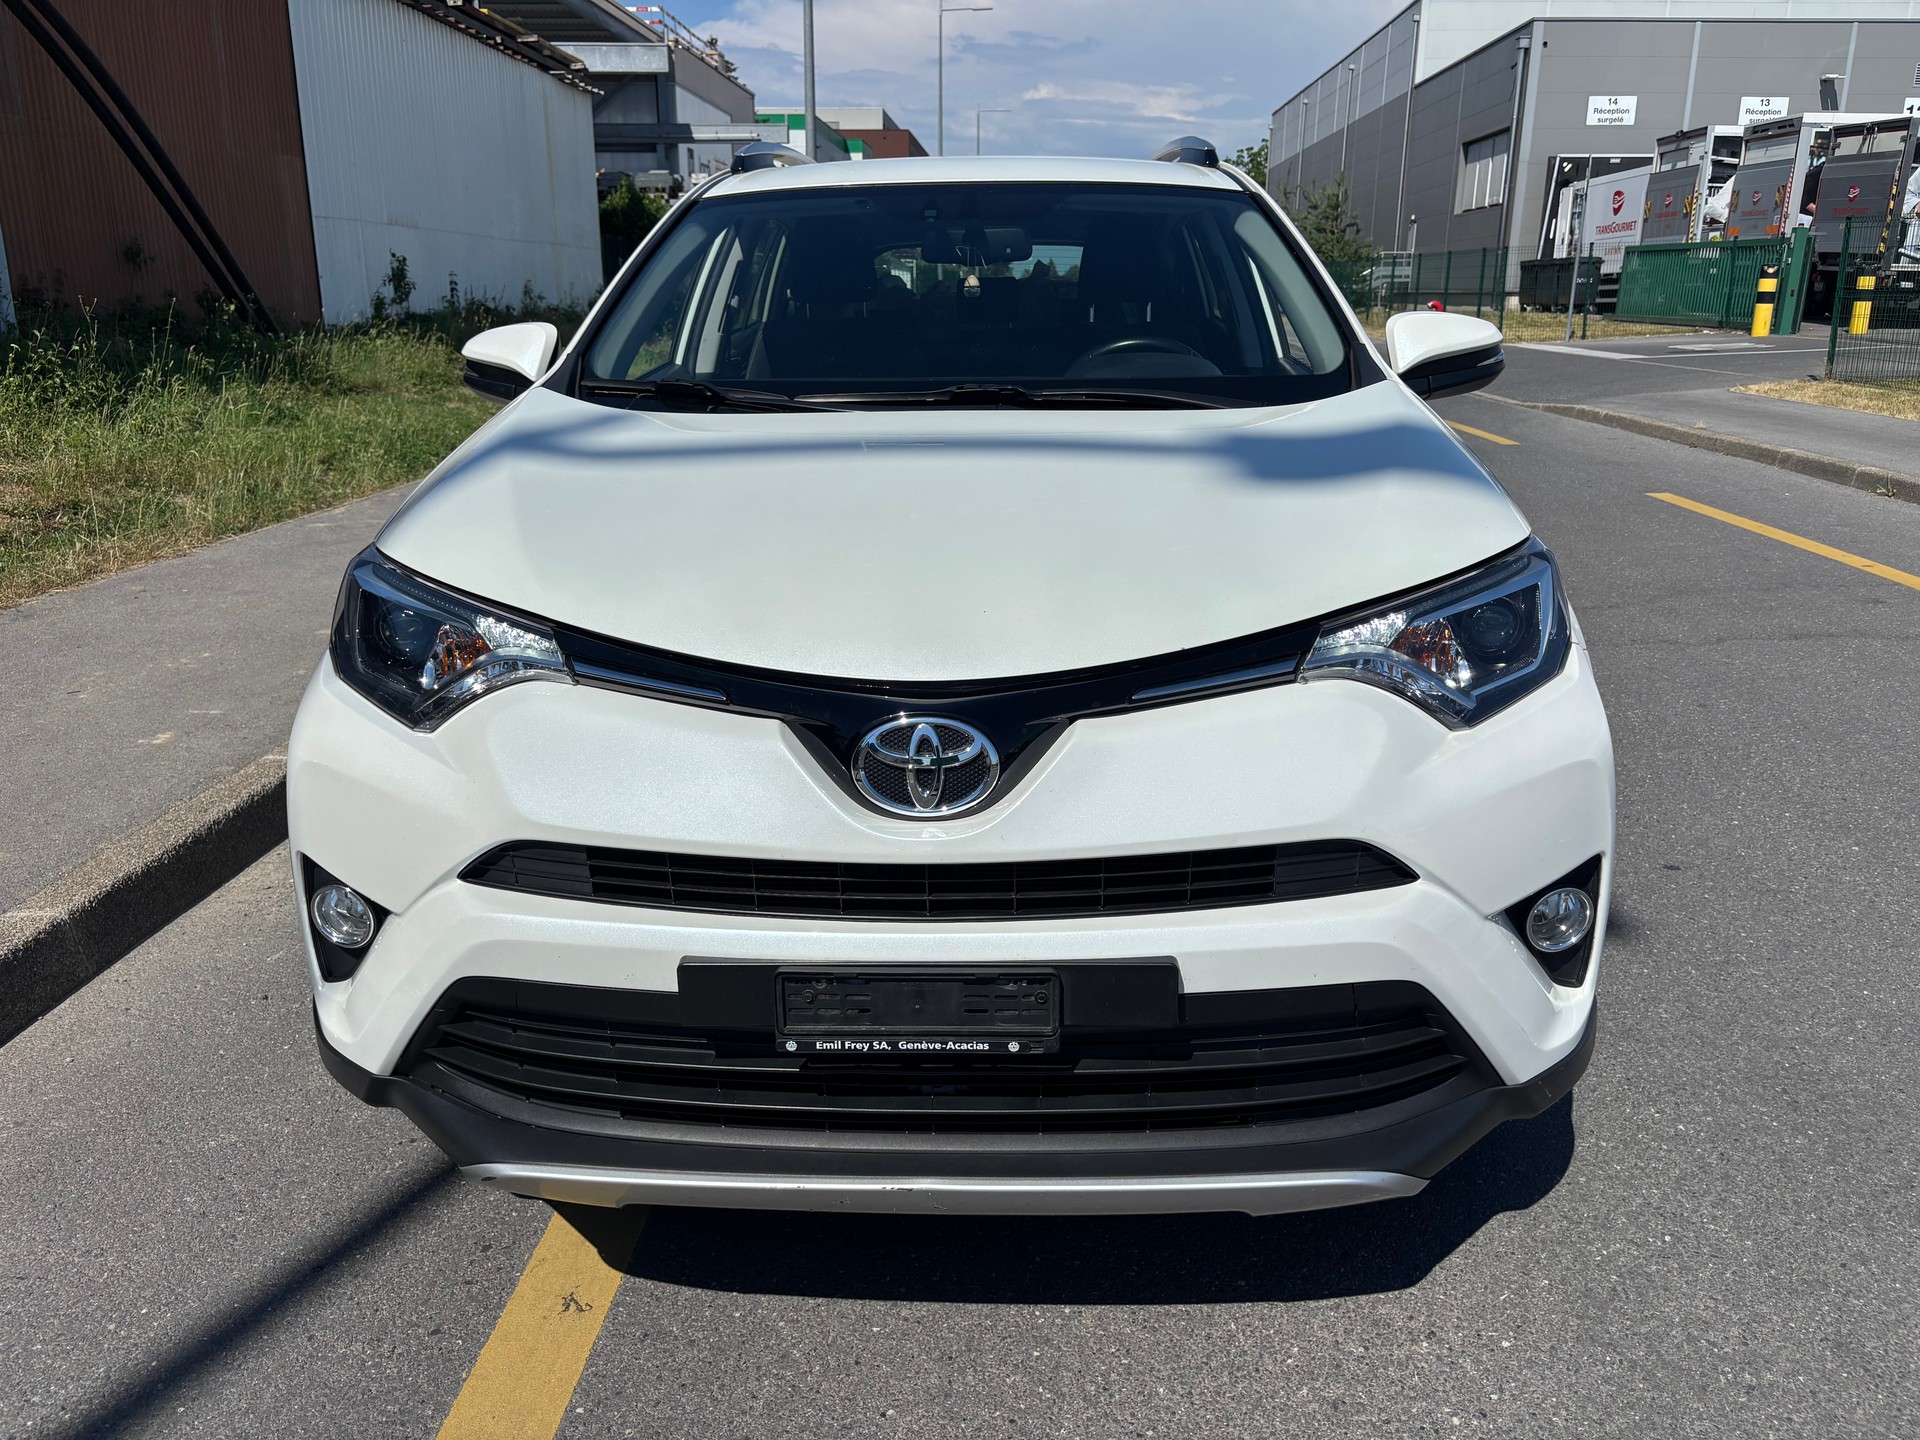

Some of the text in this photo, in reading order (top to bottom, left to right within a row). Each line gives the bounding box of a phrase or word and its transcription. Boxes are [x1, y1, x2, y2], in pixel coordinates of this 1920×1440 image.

[1608, 97, 1618, 106] 14
[1760, 98, 1771, 107] 13
[1593, 107, 1630, 116] Réception
[1745, 107, 1782, 116] Réception
[1597, 116, 1624, 124] surgelé
[1595, 220, 1637, 235] TRANSGOURMET
[816, 1040, 990, 1052] Emil Frey SA, Genève-Acacias
